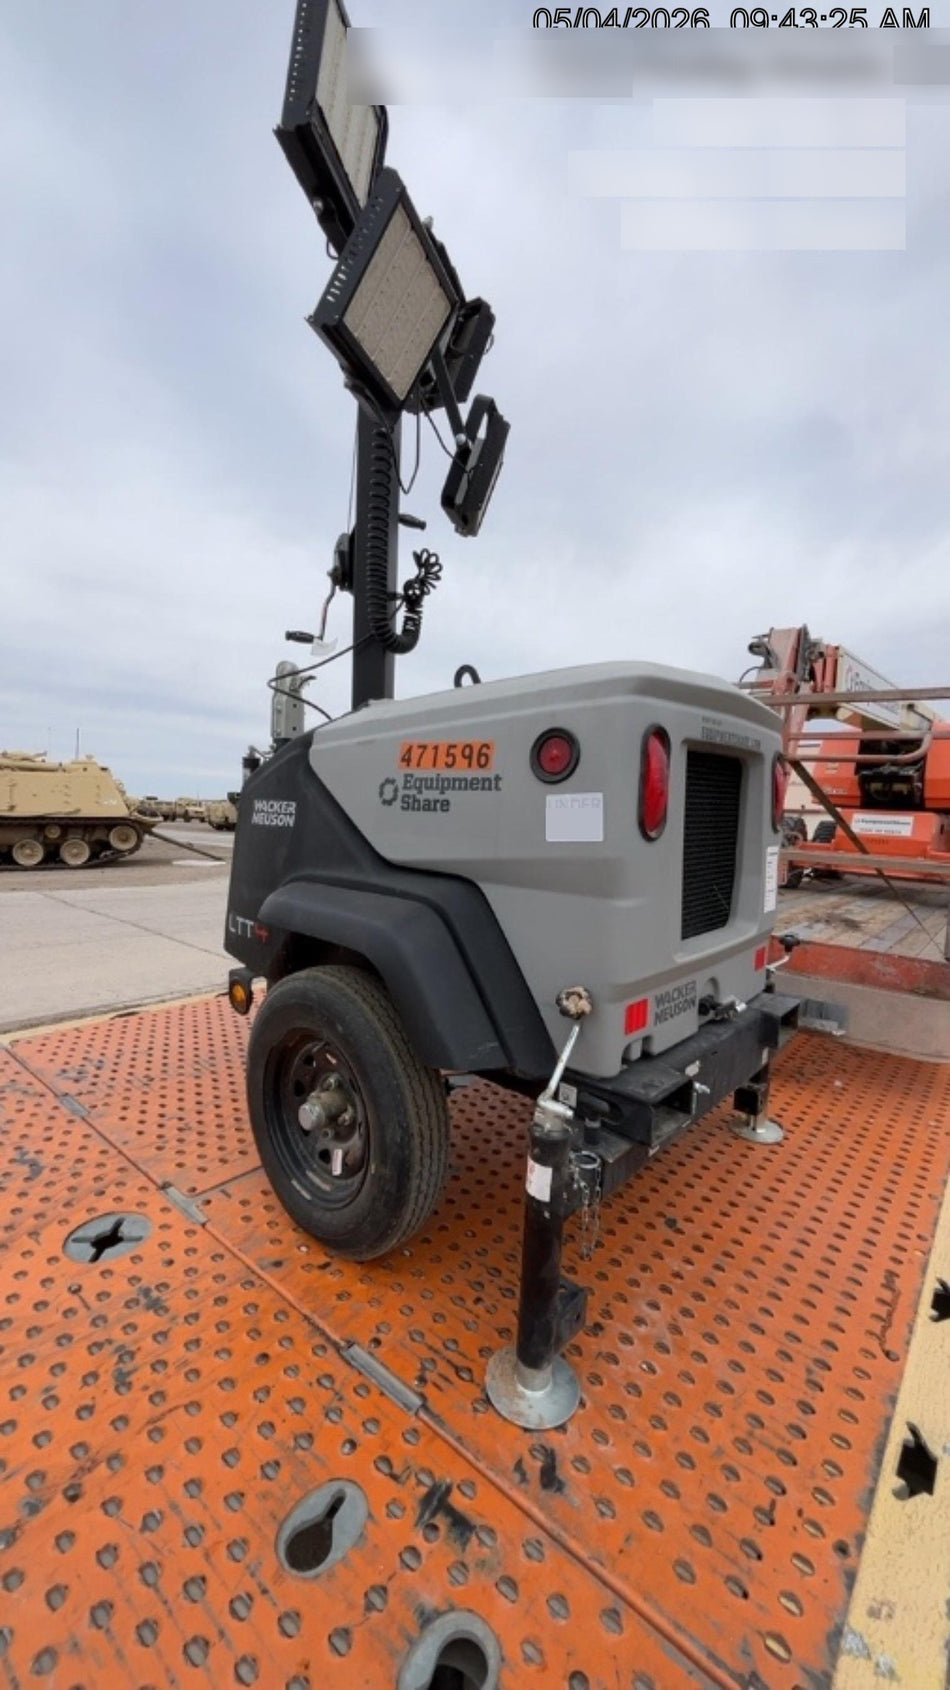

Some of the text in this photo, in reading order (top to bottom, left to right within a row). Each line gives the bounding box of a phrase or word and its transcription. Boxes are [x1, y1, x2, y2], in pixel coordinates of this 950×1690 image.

[401, 743, 491, 768] 471596
[402, 773, 502, 794] Equipment
[254, 800, 297, 814] WACKER
[401, 794, 450, 812] Share
[252, 812, 295, 827] NEUSON
[655, 980, 697, 1008] WACKER
[655, 996, 696, 1026] NEUSON
